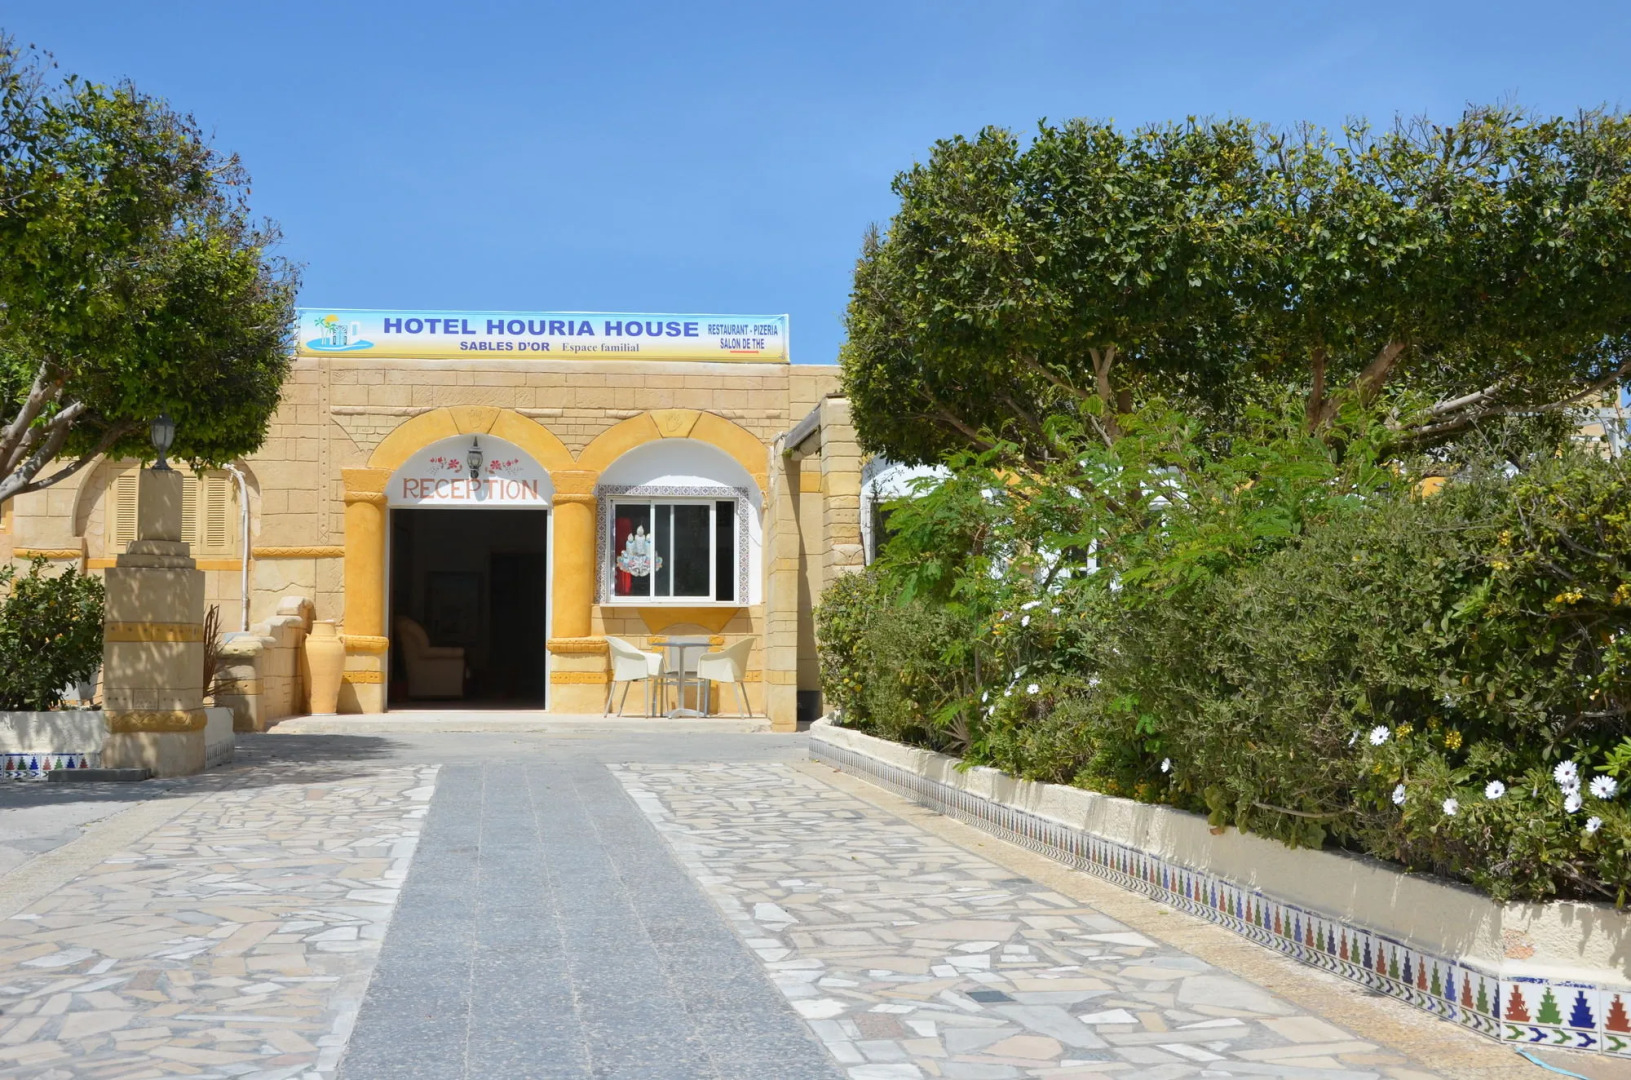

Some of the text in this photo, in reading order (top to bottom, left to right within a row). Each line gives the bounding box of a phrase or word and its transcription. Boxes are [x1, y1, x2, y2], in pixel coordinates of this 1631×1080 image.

[383, 317, 699, 337] HOTEL HOURIA HOUSE
[707, 324, 749, 335] RESTAURANT
[753, 324, 778, 336] PIZERIA
[459, 341, 550, 352] SABLES D'OR
[562, 342, 640, 354] Espace familial
[720, 338, 765, 349] SALON DE THE
[403, 478, 538, 500] RECEPTION
